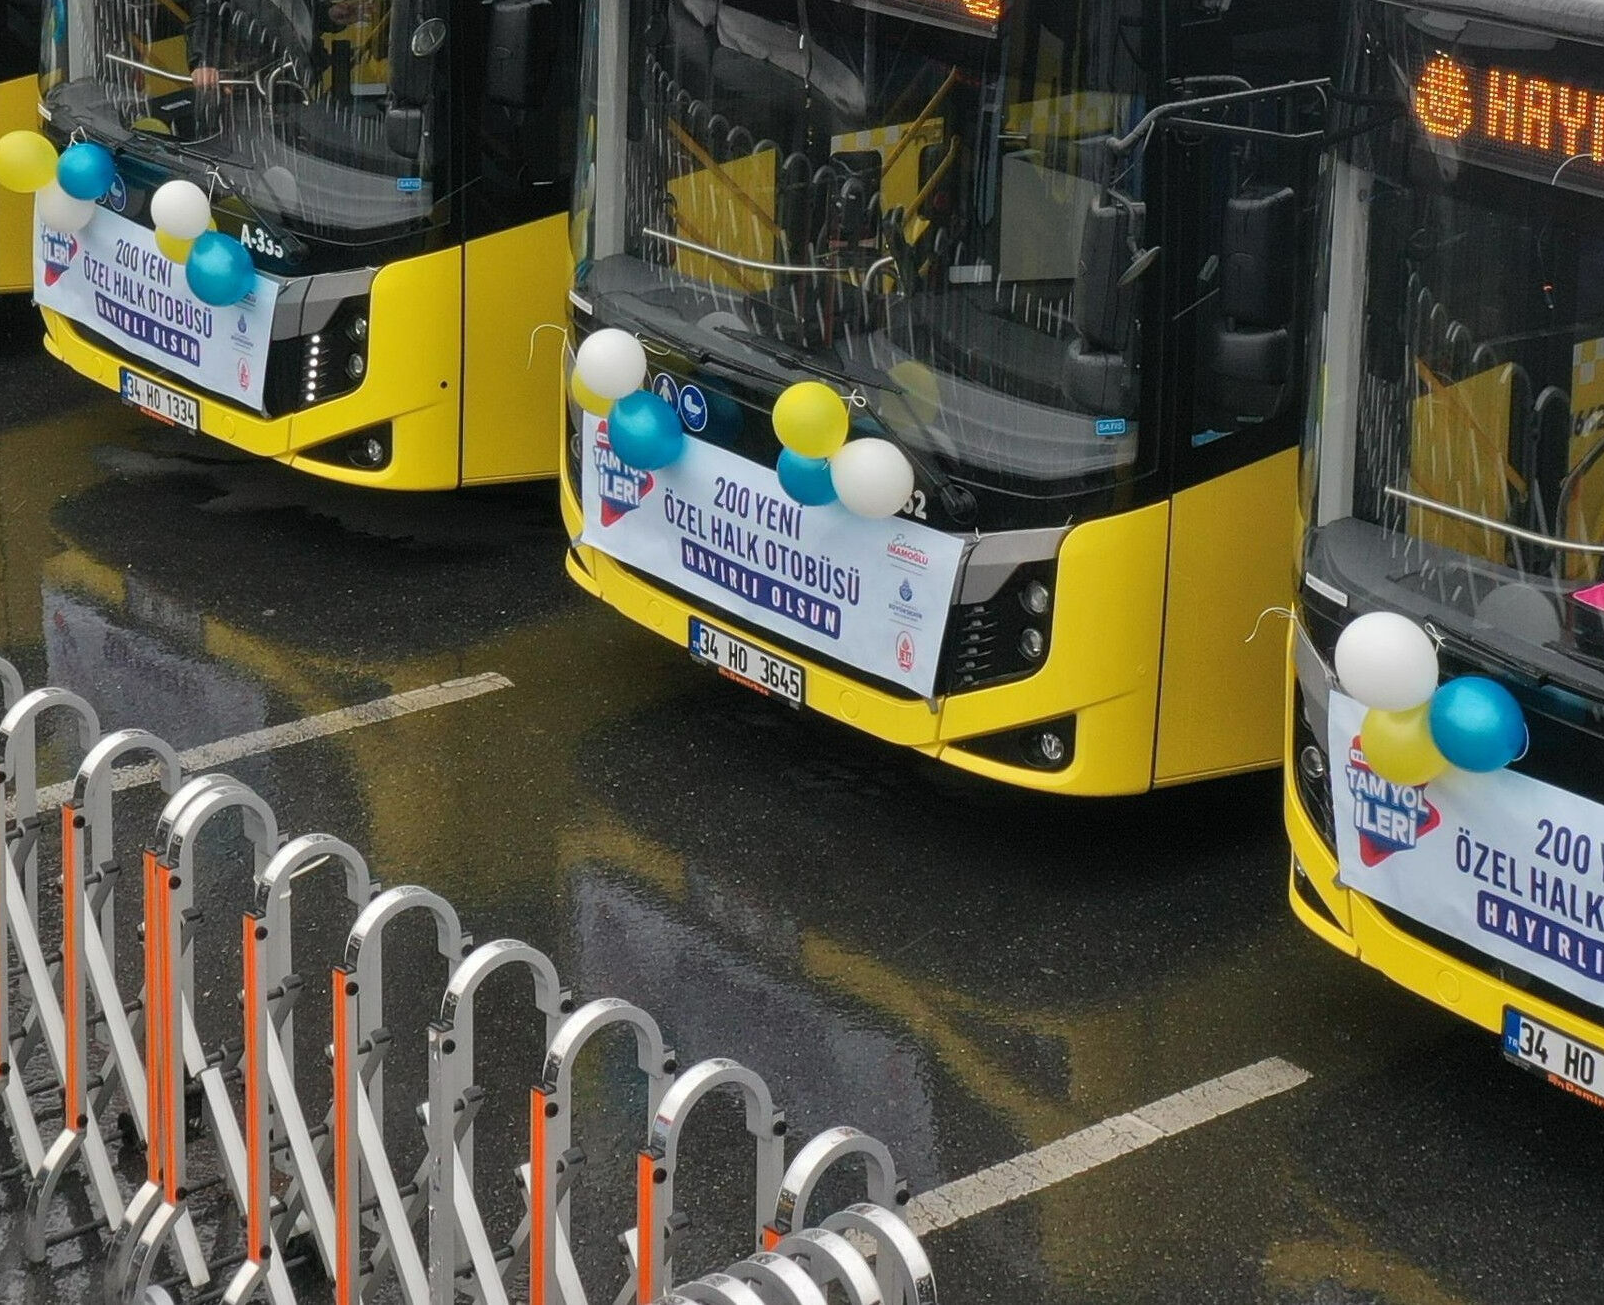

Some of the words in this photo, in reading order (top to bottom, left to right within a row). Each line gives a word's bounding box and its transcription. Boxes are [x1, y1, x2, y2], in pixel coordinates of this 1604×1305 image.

[83, 252, 111, 293] ÖZEL
[114, 273, 147, 313] HALK
[148, 291, 213, 339] OTOBÜSÜ
[115, 238, 138, 272] 200
[141, 250, 173, 288] YENİ
[153, 328, 198, 362] OLSUN
[127, 375, 141, 401] 34
[146, 383, 161, 410] HO
[166, 393, 195, 425] 1334
[600, 466, 640, 506] İLERİ
[714, 476, 750, 520] 200
[755, 493, 803, 541] YENİ
[663, 486, 707, 541] ÖZEL
[711, 514, 760, 565] HALK
[764, 539, 861, 607] OTOBÜSÜ
[685, 549, 759, 600] HAYIRLI
[770, 585, 837, 633] OLSUN
[700, 627, 718, 660] 34
[728, 640, 748, 674] HO
[759, 655, 800, 698] 3645
[1346, 766, 1388, 802] TAM
[1390, 782, 1431, 814] YOL
[1354, 792, 1417, 847] İLERİ
[1535, 818, 1592, 875] 200
[1455, 826, 1523, 897] ÖZEL
[1529, 866, 1604, 934] HALK
[1484, 898, 1604, 975] HAYIRLI
[1520, 1022, 1548, 1064] 34
[1564, 1042, 1595, 1087] HO
